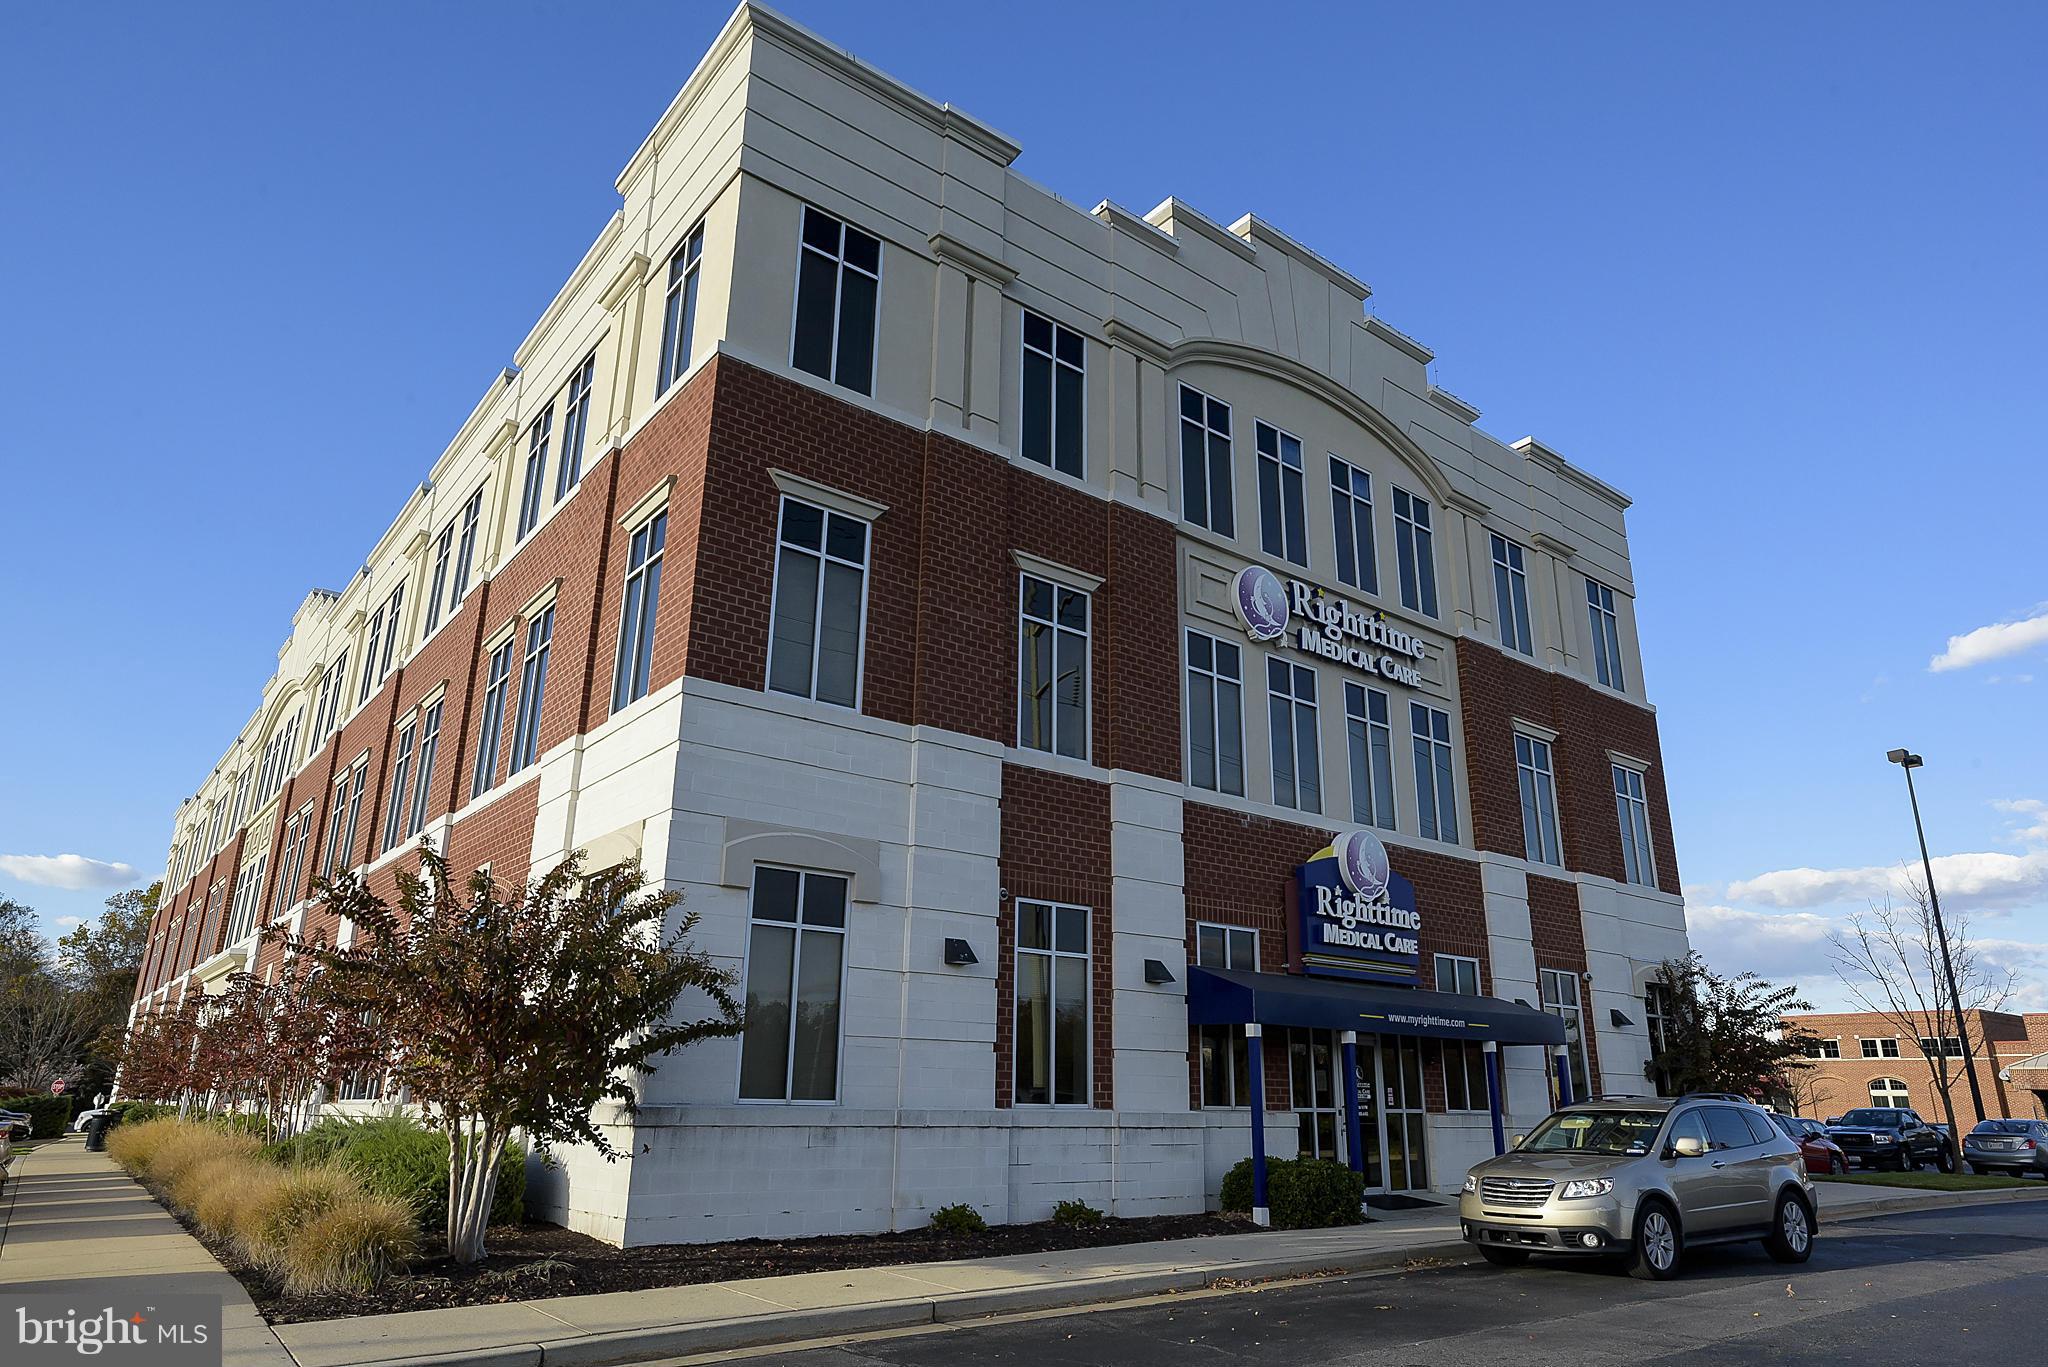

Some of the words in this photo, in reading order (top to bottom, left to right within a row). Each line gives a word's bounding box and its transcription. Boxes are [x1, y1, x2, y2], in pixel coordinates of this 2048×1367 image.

[1290, 579, 1425, 660] Righttime
[1302, 627, 1378, 674] MEDICAL
[1380, 656, 1422, 688] CARE
[1315, 885, 1421, 930] Righttime
[1323, 923, 1384, 951] MEDICAL
[1384, 932, 1419, 955] CARE
[1388, 1014, 1465, 1027] www.myrighttime.com
